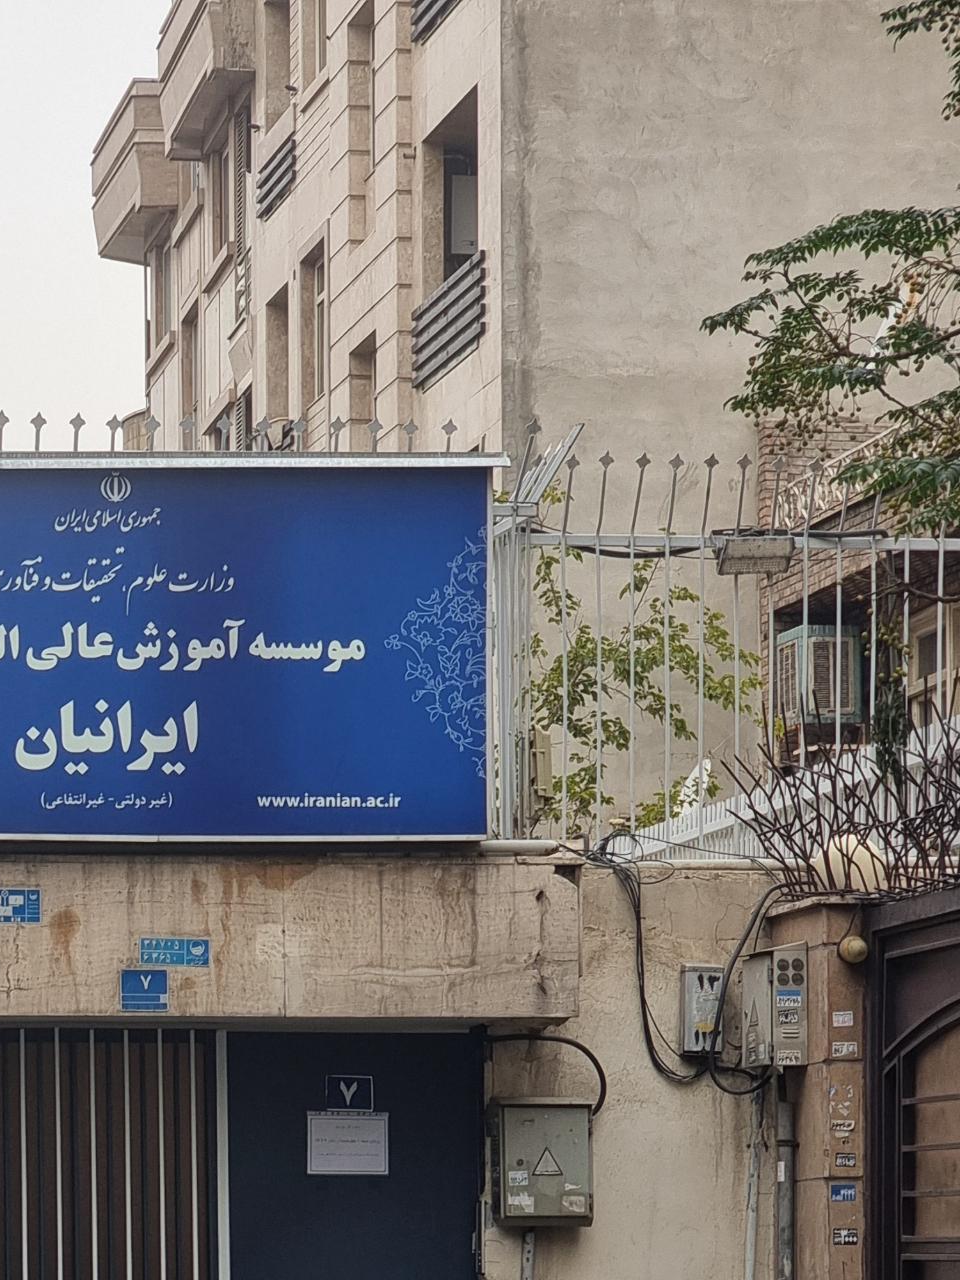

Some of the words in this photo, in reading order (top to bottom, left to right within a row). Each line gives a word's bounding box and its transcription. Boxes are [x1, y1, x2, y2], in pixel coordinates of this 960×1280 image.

[54, 508, 87, 532] ایران
[84, 508, 122, 532] اسلامی
[120, 506, 161, 532] جمهوری
[40, 575, 52, 592] و
[51, 546, 125, 603] تحقیقات
[168, 564, 235, 593] وزارت
[25, 621, 115, 671] عالی
[116, 618, 246, 672] آموزش
[248, 631, 367, 672] موسسه
[14, 700, 199, 775] ایرانیان
[257, 792, 402, 808] www.iranian.ac.ir
[140, 973, 152, 990] ۷
[339, 1080, 358, 1107] ۷
